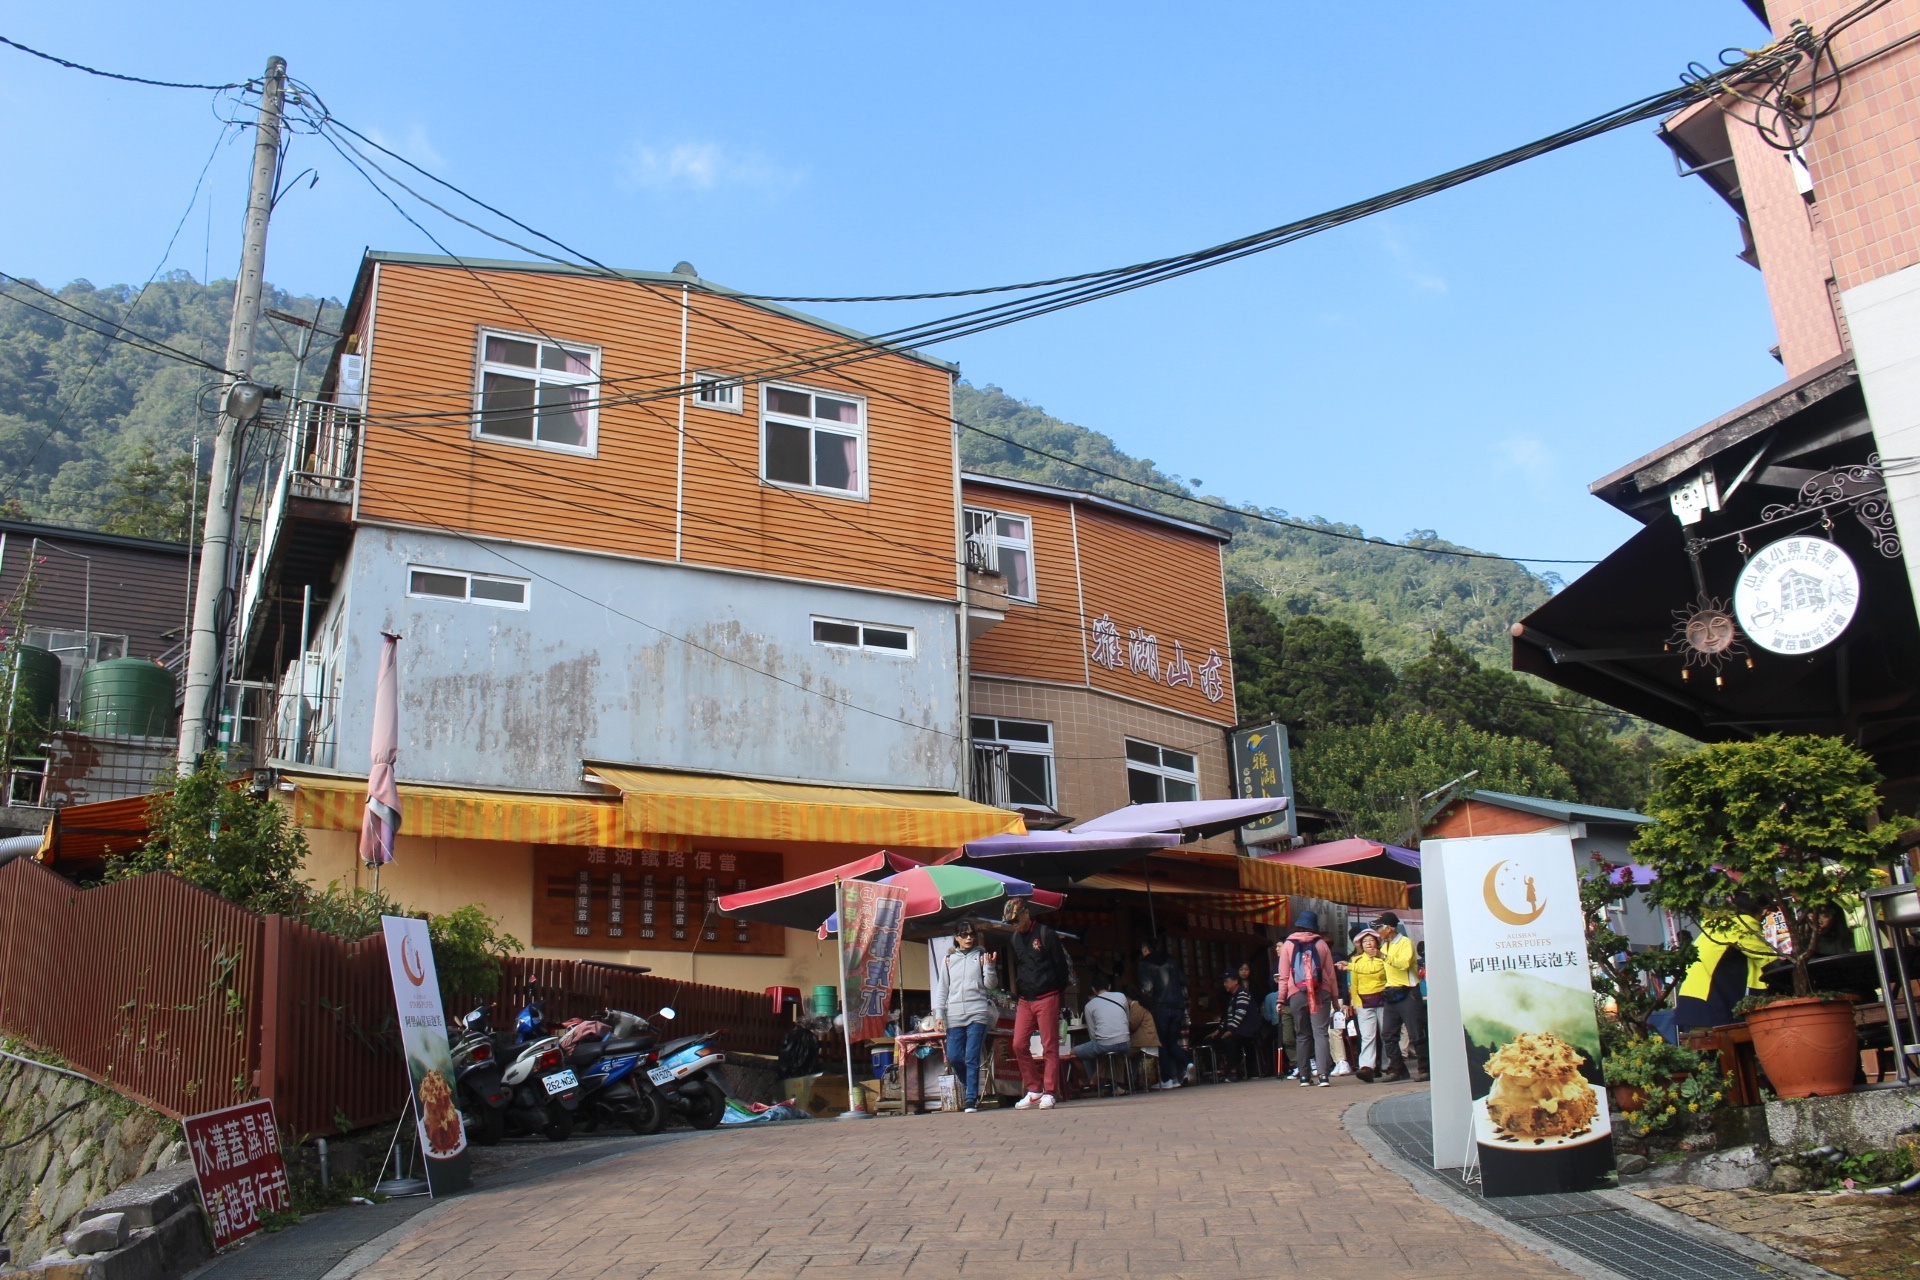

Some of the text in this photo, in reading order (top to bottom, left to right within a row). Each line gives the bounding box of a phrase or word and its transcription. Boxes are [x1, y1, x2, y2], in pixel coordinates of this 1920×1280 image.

[1764, 564, 1777, 574] Lan
[1779, 555, 1808, 564] Amazing
[588, 845, 736, 871] 雅湖鐵路便當
[576, 927, 588, 935] 100
[609, 928, 621, 936] 100
[642, 930, 654, 938] 100
[676, 931, 684, 939] 90
[1495, 938, 1551, 949] STARS PUFFS
[1469, 951, 1578, 973] 阿里山星辰泡芙
